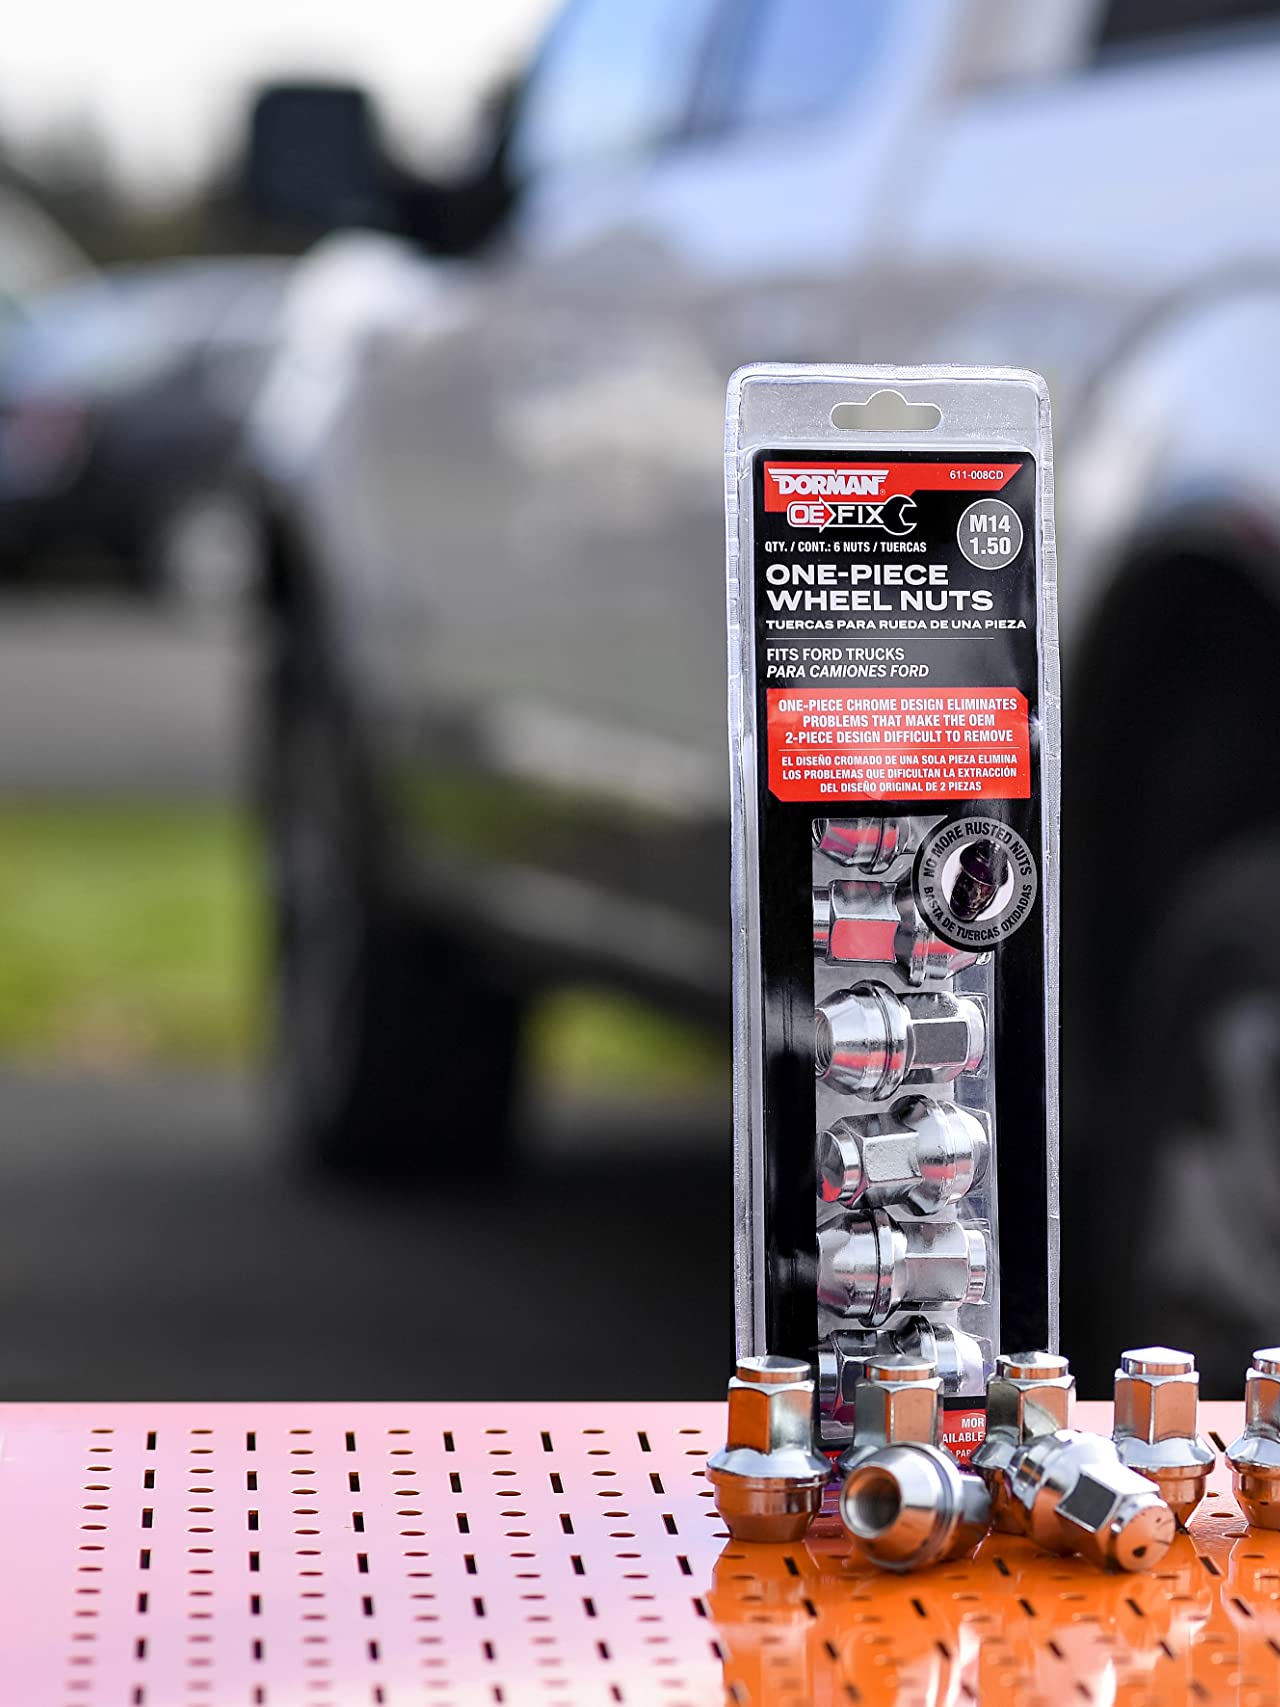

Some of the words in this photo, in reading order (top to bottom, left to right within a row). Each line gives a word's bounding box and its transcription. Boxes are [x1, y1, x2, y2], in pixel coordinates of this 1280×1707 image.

[770, 469, 888, 495] DORMAN
[950, 470, 1004, 480] 611-008CD
[790, 505, 826, 524] OE
[836, 505, 884, 524] FIX
[969, 515, 1010, 532] M14
[765, 542, 787, 552] QTY.
[790, 542, 795, 552] /
[798, 542, 832, 552] CONT.:
[834, 542, 840, 552] 6
[843, 542, 870, 552] NUTS
[872, 542, 877, 552] /
[879, 542, 926, 552] TUERCAS
[970, 538, 1011, 555] 1.50
[766, 564, 948, 586] ONE-PIECE
[766, 590, 892, 612] WHEEL
[900, 590, 994, 612] NUTS
[766, 620, 834, 630] TUERCAS
[836, 620, 876, 629] PARA
[879, 620, 928, 629] RUEDA
[931, 620, 948, 629] DE
[951, 620, 982, 629] UNA
[984, 620, 1026, 629] PIEZA
[766, 648, 799, 661] FITS
[802, 648, 842, 661] FORD
[848, 648, 905, 661] TRUCKS
[766, 666, 806, 678] PARA
[809, 665, 886, 678] CAMIONES
[890, 664, 929, 677] FORD
[778, 700, 843, 712] ONE-PIECE
[846, 699, 897, 711] CHROME
[900, 699, 944, 711] DESIGN
[947, 698, 1017, 710] ELIMINATES
[803, 715, 868, 728] PROBLEMS
[872, 715, 902, 727] THAT
[905, 715, 940, 726] MAKE
[943, 714, 966, 726] THE
[969, 714, 995, 726] OEM
[785, 731, 833, 744] 2-PIECE
[836, 731, 880, 743] DESIGN
[884, 731, 942, 743] DIFFICULT
[944, 730, 961, 742] TO
[964, 730, 1013, 742] REMOVE
[782, 757, 793, 767] EL
[796, 754, 832, 766] DISEÑO
[834, 756, 882, 766] CROMADO
[885, 756, 898, 766] DE
[900, 755, 919, 766] UNA
[921, 755, 946, 765] SOLA
[948, 754, 976, 764] PIEZA
[978, 754, 1017, 764] ELIMINA
[782, 770, 801, 780] LOS
[804, 769, 864, 780] PROBLEMAS
[866, 769, 885, 780] QUE
[887, 768, 941, 778] DIFICULTAN
[943, 768, 956, 778] LA
[958, 766, 1017, 778] EXTRACCIÓN
[820, 783, 838, 793] DEL
[840, 781, 877, 792] DISEÑO
[879, 782, 923, 792] ORIGINAL
[926, 782, 938, 791] DE
[940, 782, 946, 791] 2
[948, 782, 982, 791] PIEZAS
[923, 858, 937, 878] NO
[932, 825, 964, 858] MORE
[965, 822, 1013, 844] RUSTED
[1010, 841, 1032, 876] NUTS
[924, 887, 944, 919] BASTA
[942, 918, 955, 932] DE
[957, 926, 1001, 941] TUERCAS
[1000, 884, 1032, 932] OXIDADAS
[962, 1418, 984, 1428] MOR
[942, 1432, 986, 1443] AILABLE
